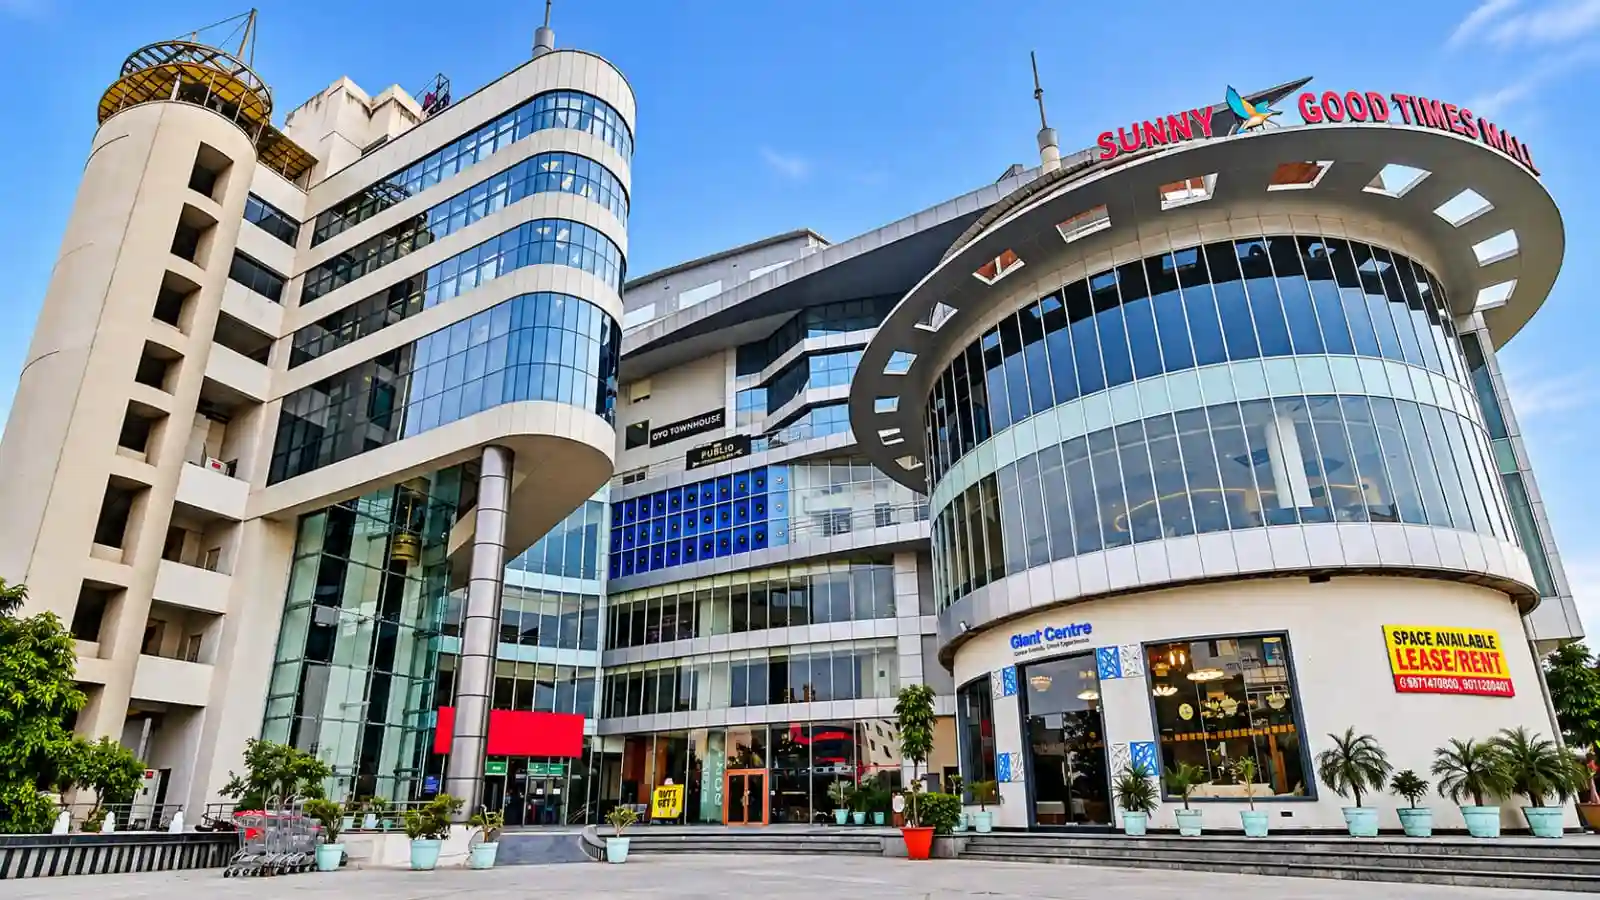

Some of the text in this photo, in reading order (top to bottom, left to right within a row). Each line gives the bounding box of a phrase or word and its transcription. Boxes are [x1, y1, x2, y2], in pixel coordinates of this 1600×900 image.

[1097, 91, 1541, 177] SUNNY GOOD TIMES MALL
[652, 413, 721, 441] OYO TOWNHOUSE
[1010, 629, 1043, 649] Giant
[1044, 623, 1092, 641] Centre
[1392, 631, 1496, 649] SPACE AVAILABLE
[1395, 648, 1502, 674] LEASE/RENT
